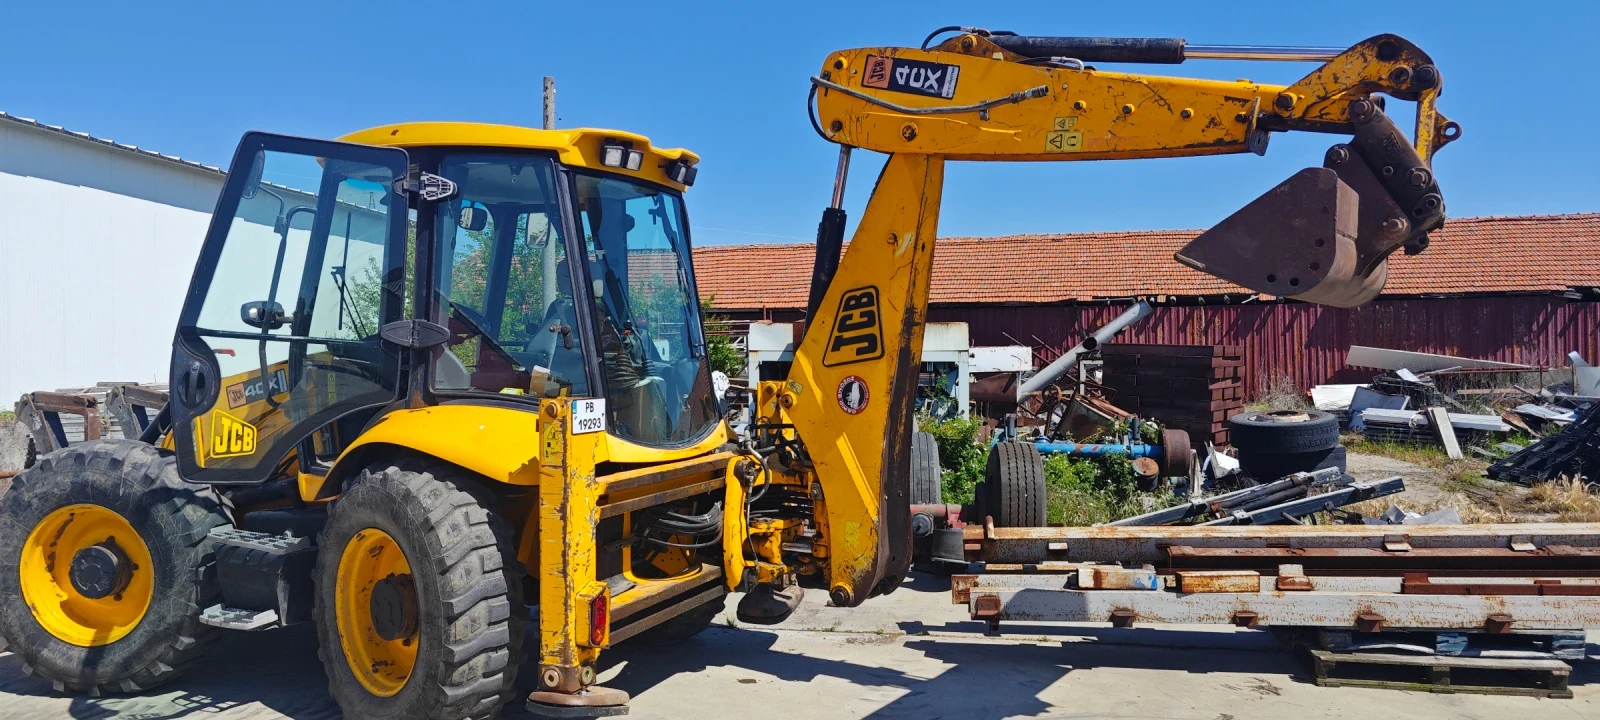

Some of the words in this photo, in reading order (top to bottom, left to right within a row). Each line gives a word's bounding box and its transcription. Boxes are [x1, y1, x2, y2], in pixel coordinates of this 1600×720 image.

[869, 61, 884, 80] JCB
[895, 65, 942, 91] 4CX
[831, 291, 878, 357] JCB
[231, 390, 244, 402] JCB
[585, 402, 594, 413] PB
[578, 417, 601, 430] 19293
[214, 416, 254, 453] JCB
